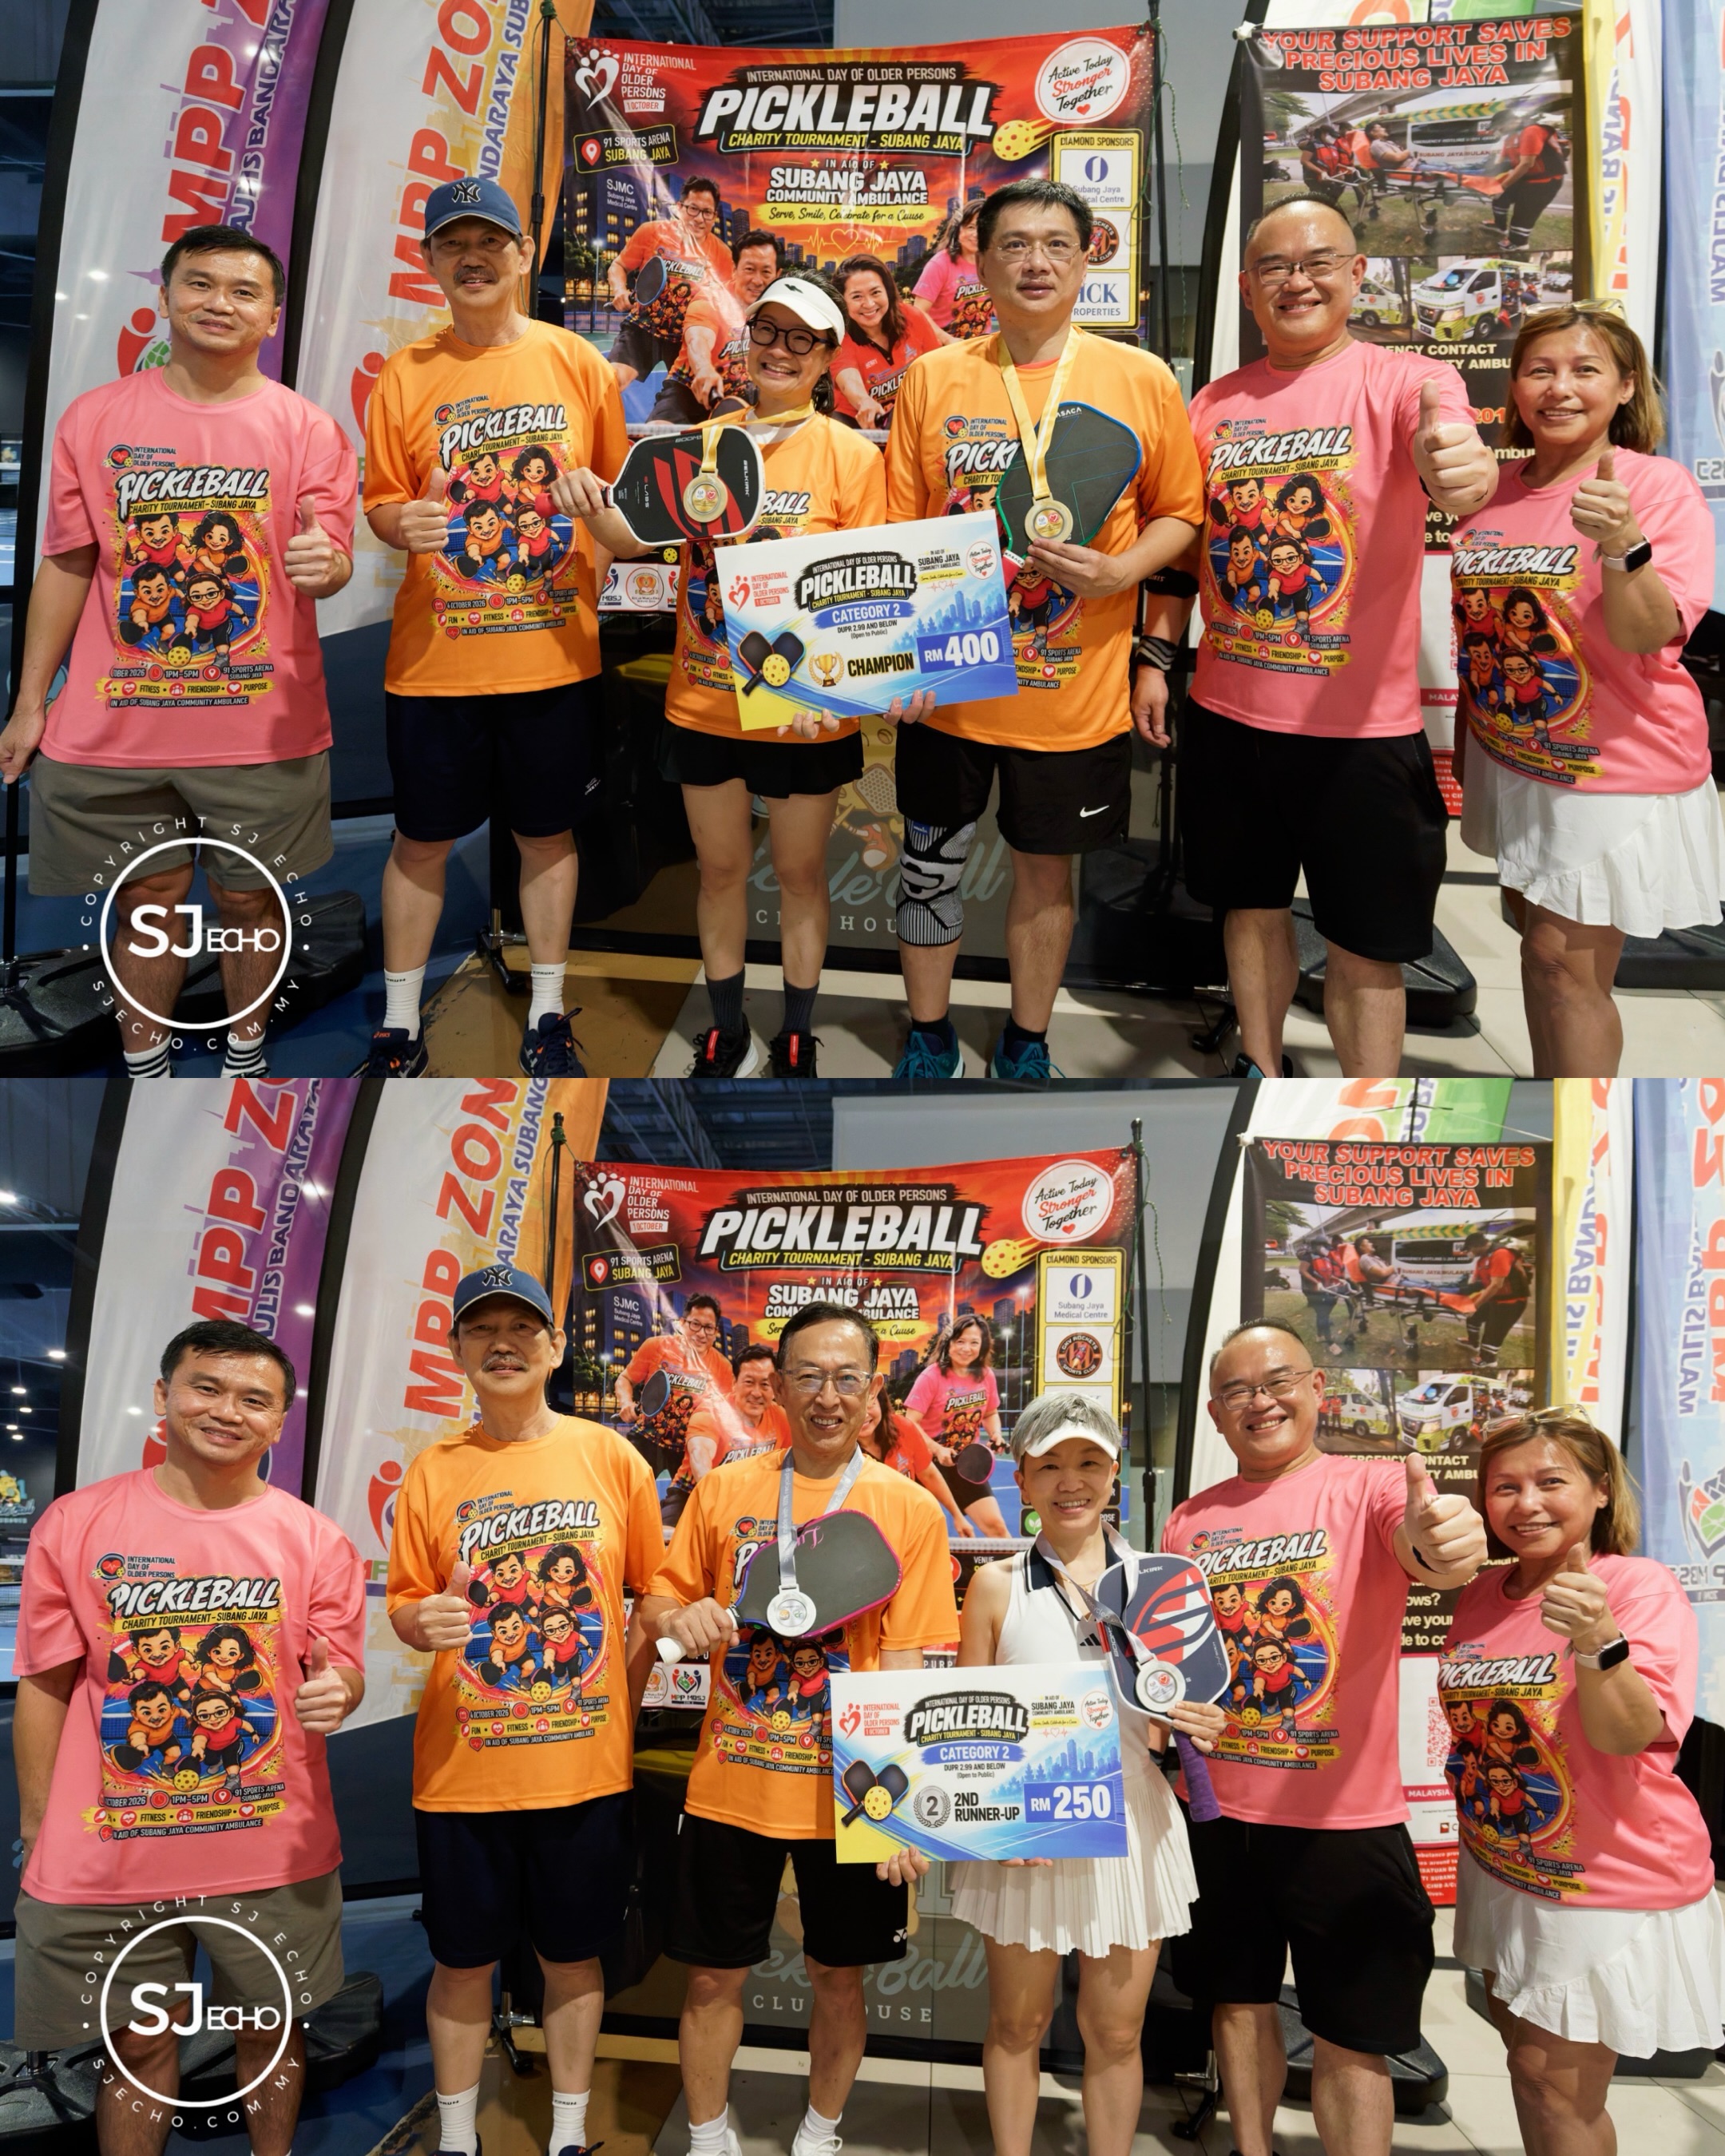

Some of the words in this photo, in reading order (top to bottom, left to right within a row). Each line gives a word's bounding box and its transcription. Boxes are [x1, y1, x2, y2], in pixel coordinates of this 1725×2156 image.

[1262, 30, 1334, 51] YOUR
[1342, 26, 1468, 50] SUPPORT
[1478, 18, 1572, 43] SAVES
[624, 53, 696, 70] INTERNATIONAL
[1285, 49, 1418, 69] PRECIOUS
[1426, 44, 1506, 67] LIVES
[1516, 42, 1546, 61] IN
[622, 63, 641, 73] DAY
[747, 69, 825, 82] INTERNATIONAL
[828, 69, 849, 81] DAY
[851, 69, 864, 81] OF
[867, 68, 902, 81] OLDER
[906, 68, 957, 79] PERSONS
[1048, 65, 1081, 83] Active
[1084, 54, 1114, 73] Today
[621, 73, 653, 86] OLDER
[1052, 66, 1112, 98] Stronger
[1319, 69, 1430, 92] SUBANG
[1440, 65, 1509, 86] JAYA
[621, 86, 666, 99] PERSONS
[1056, 85, 1113, 112] Together
[632, 101, 659, 110] OCTOBER
[698, 84, 993, 137] PICKLEBALL
[603, 138, 613, 147] 91
[614, 137, 647, 147] SPORTS
[648, 133, 670, 145] ARENA
[728, 134, 781, 147] CHARITY
[785, 134, 867, 148] TOURNAMENT
[880, 134, 930, 149] SUBANG
[933, 136, 963, 150] JAYA
[1061, 137, 1095, 146] DIAMOND
[1097, 137, 1134, 147] SPONSORS
[605, 149, 647, 161] SUBANG
[650, 148, 671, 160] JAYA
[841, 160, 858, 168] AID
[863, 161, 874, 169] OF
[606, 178, 634, 195] SJMC
[770, 167, 864, 192] SUBANG
[870, 171, 926, 191] JAYA
[767, 188, 846, 204] COMMUNITY
[851, 192, 928, 205] AMBULANCE
[768, 208, 795, 221] Serve,
[798, 208, 826, 221] Smile,
[829, 208, 870, 220] Celebrate
[873, 211, 886, 221] for
[896, 211, 925, 222] Cause
[1426, 344, 1497, 355] CONTACT
[441, 406, 567, 470] PICKLEBALL
[1206, 428, 1350, 484] PICKLEBALL
[1221, 469, 1247, 480] CHARITY
[1249, 466, 1290, 476] TOURNAMENT
[1295, 461, 1319, 472] SUBANG
[1321, 458, 1338, 468] JAYA
[118, 469, 268, 521] PICKLEBALL
[812, 560, 845, 574] INTERNATIONAL
[918, 557, 942, 566] SUBANG
[945, 553, 960, 562] JAYA
[1453, 545, 1580, 575] PICKLEBALL
[801, 565, 914, 605] PICKLEBALL
[811, 596, 833, 608] CHARITY
[834, 590, 866, 603] TOURNAMENT
[832, 604, 890, 624] CATEGORY
[894, 603, 901, 616] 2
[847, 653, 914, 677] CHAMPION
[1264, 1141, 1330, 1163] YOUR
[1335, 1143, 1450, 1167] SUPPORT
[1455, 1147, 1536, 1167] SAVES
[1285, 1161, 1403, 1186] PRECIOUS
[1410, 1167, 1478, 1188] LIVES
[1485, 1168, 1513, 1187] IN
[1315, 1185, 1413, 1206] SUBANG
[1419, 1187, 1481, 1208] JAYA
[700, 1205, 983, 1255] PICKLEBALL
[729, 1252, 780, 1266] CHARITY
[783, 1252, 862, 1266] TOURNAMENT
[874, 1253, 922, 1266] SUBANG
[925, 1254, 954, 1268] JAYA
[768, 1285, 859, 1307] SUBANG
[864, 1289, 918, 1308] JAYA
[1058, 1302, 1084, 1311] Subang
[1087, 1302, 1104, 1311] Jaya
[1073, 1336, 1098, 1349] ROCKETS
[1063, 1364, 1081, 1374] SPORTS
[1083, 1365, 1096, 1374] CLUB
[460, 1501, 598, 1567] PICKLEBALL
[110, 1579, 279, 1616] PICKLEBALL
[122, 1617, 157, 1630] CHARITY
[159, 1615, 210, 1627] TOURNAMENT
[216, 1611, 247, 1621] SUBANG
[248, 1611, 268, 1620] JAYA
[910, 1705, 1026, 1738] PICKLEBALL
[921, 1733, 942, 1743] CHARITY
[944, 1730, 976, 1739] TOURNAMENT
[940, 1746, 999, 1761] CATEGORY
[1002, 1746, 1009, 1759] 2
[926, 1796, 938, 1816] 2
[954, 1792, 978, 1806] 2ND
[954, 1806, 1020, 1822] RUNNER-UP
